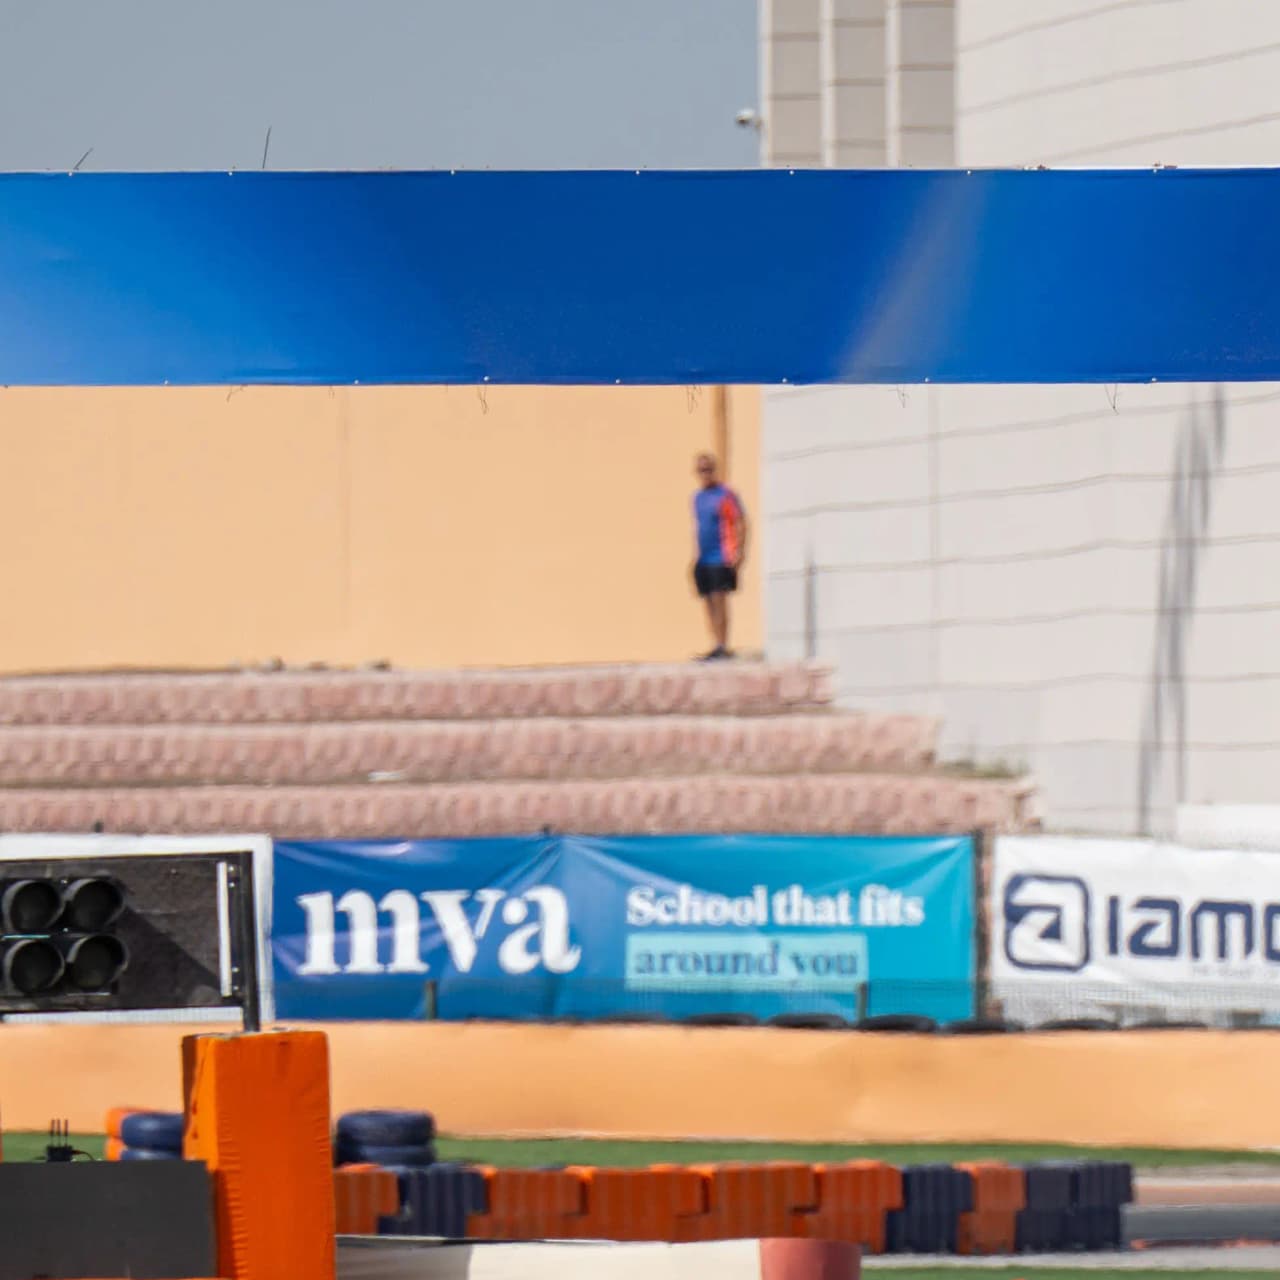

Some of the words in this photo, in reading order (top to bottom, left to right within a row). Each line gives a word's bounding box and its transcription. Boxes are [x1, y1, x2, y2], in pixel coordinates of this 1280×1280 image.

[626, 883, 769, 926] School
[772, 883, 854, 925] that
[858, 883, 926, 926] fits
[296, 883, 582, 976] mva
[634, 940, 780, 976] around
[788, 951, 859, 985] you
